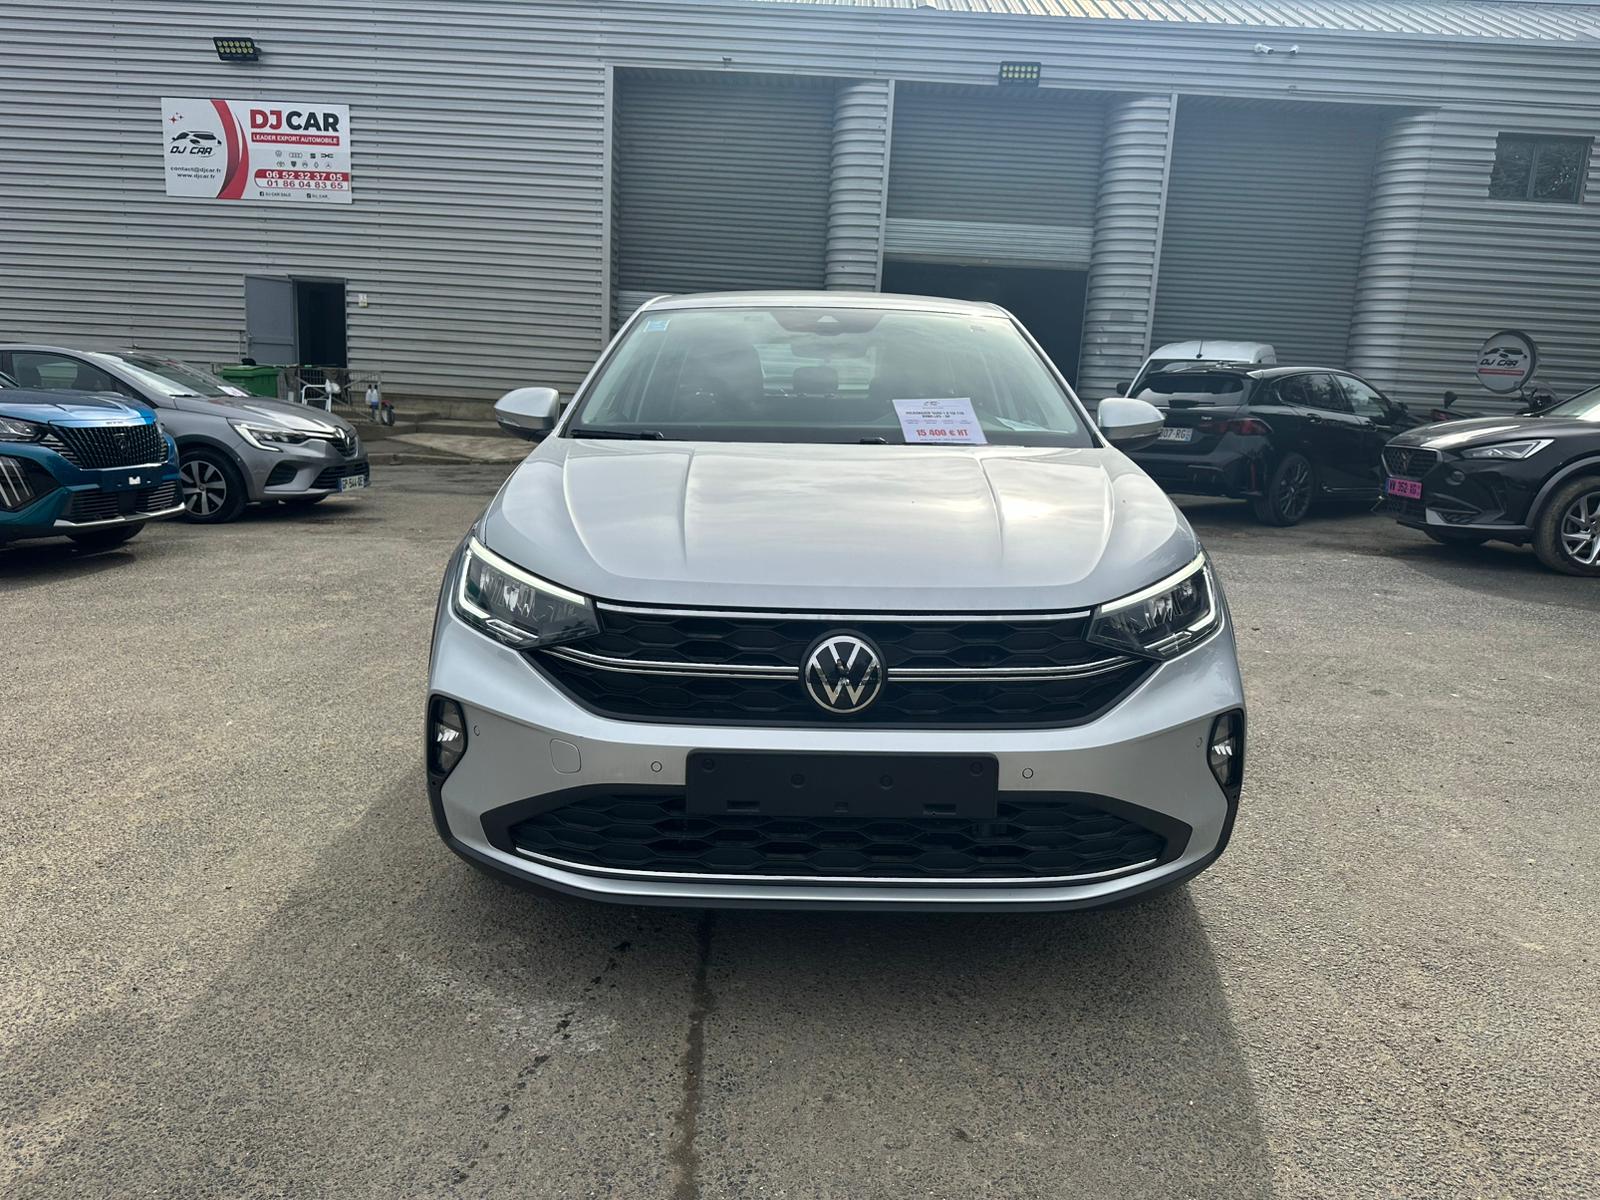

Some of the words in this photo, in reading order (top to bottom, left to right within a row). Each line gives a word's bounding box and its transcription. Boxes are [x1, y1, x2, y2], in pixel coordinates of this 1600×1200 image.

[250, 109, 282, 130] DJ
[286, 110, 339, 132] CAR
[300, 136, 337, 144] AUTOMOBILE
[170, 146, 187, 154] DJ
[189, 147, 213, 155] CAR
[266, 170, 279, 178] 06
[282, 171, 295, 180] 52
[298, 172, 311, 180] 32
[313, 172, 327, 181] 37
[329, 173, 343, 181] 05
[267, 179, 279, 187] 01
[283, 180, 296, 188] 86
[298, 180, 311, 188] 04
[314, 181, 327, 189] 83
[330, 181, 343, 190] 65
[1497, 359, 1518, 367] CAR
